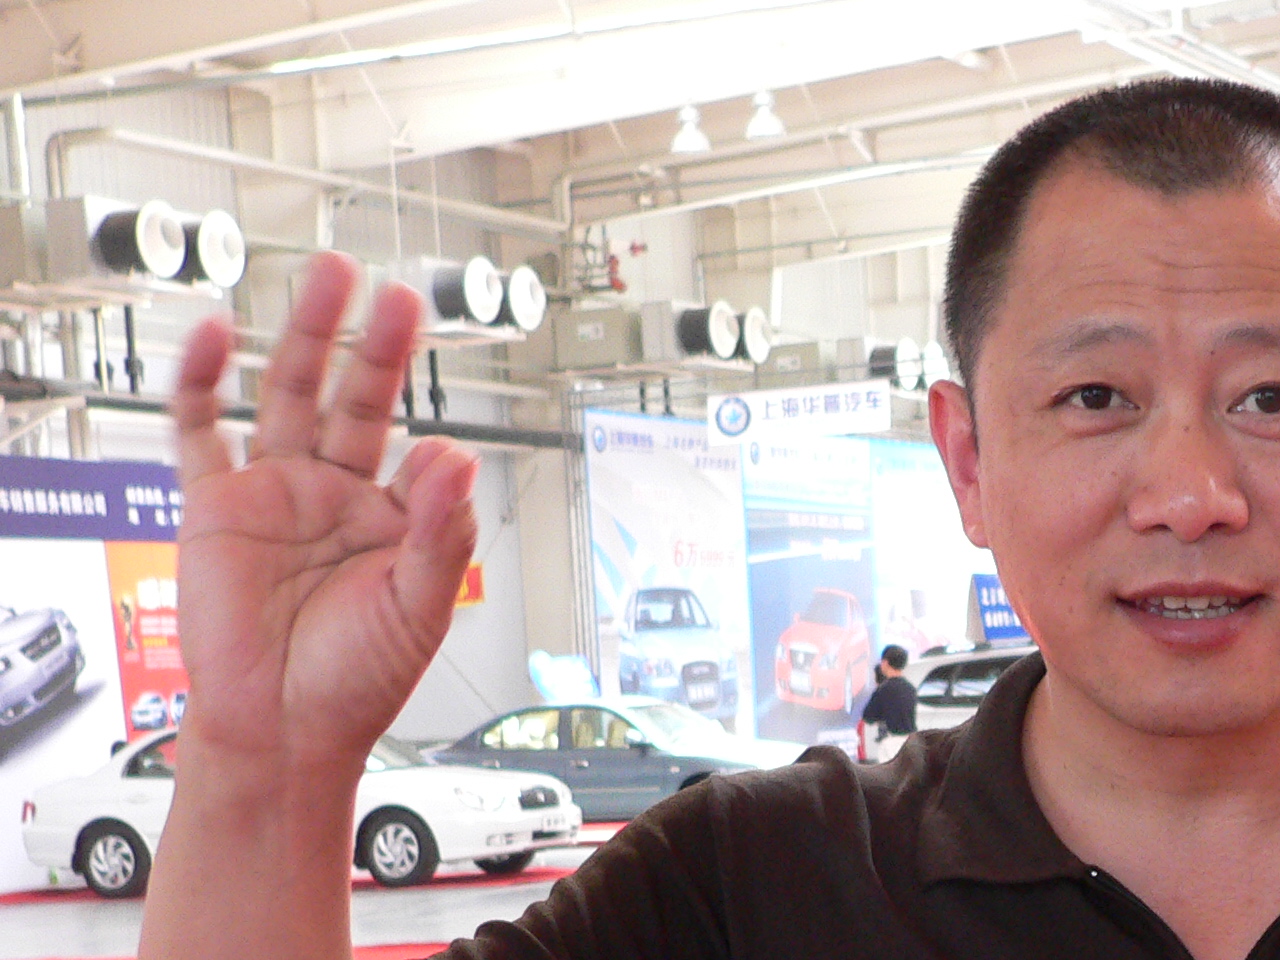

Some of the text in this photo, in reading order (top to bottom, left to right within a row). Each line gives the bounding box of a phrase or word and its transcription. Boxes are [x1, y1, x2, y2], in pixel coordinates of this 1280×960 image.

[762, 390, 883, 420] 上海华普汽车
